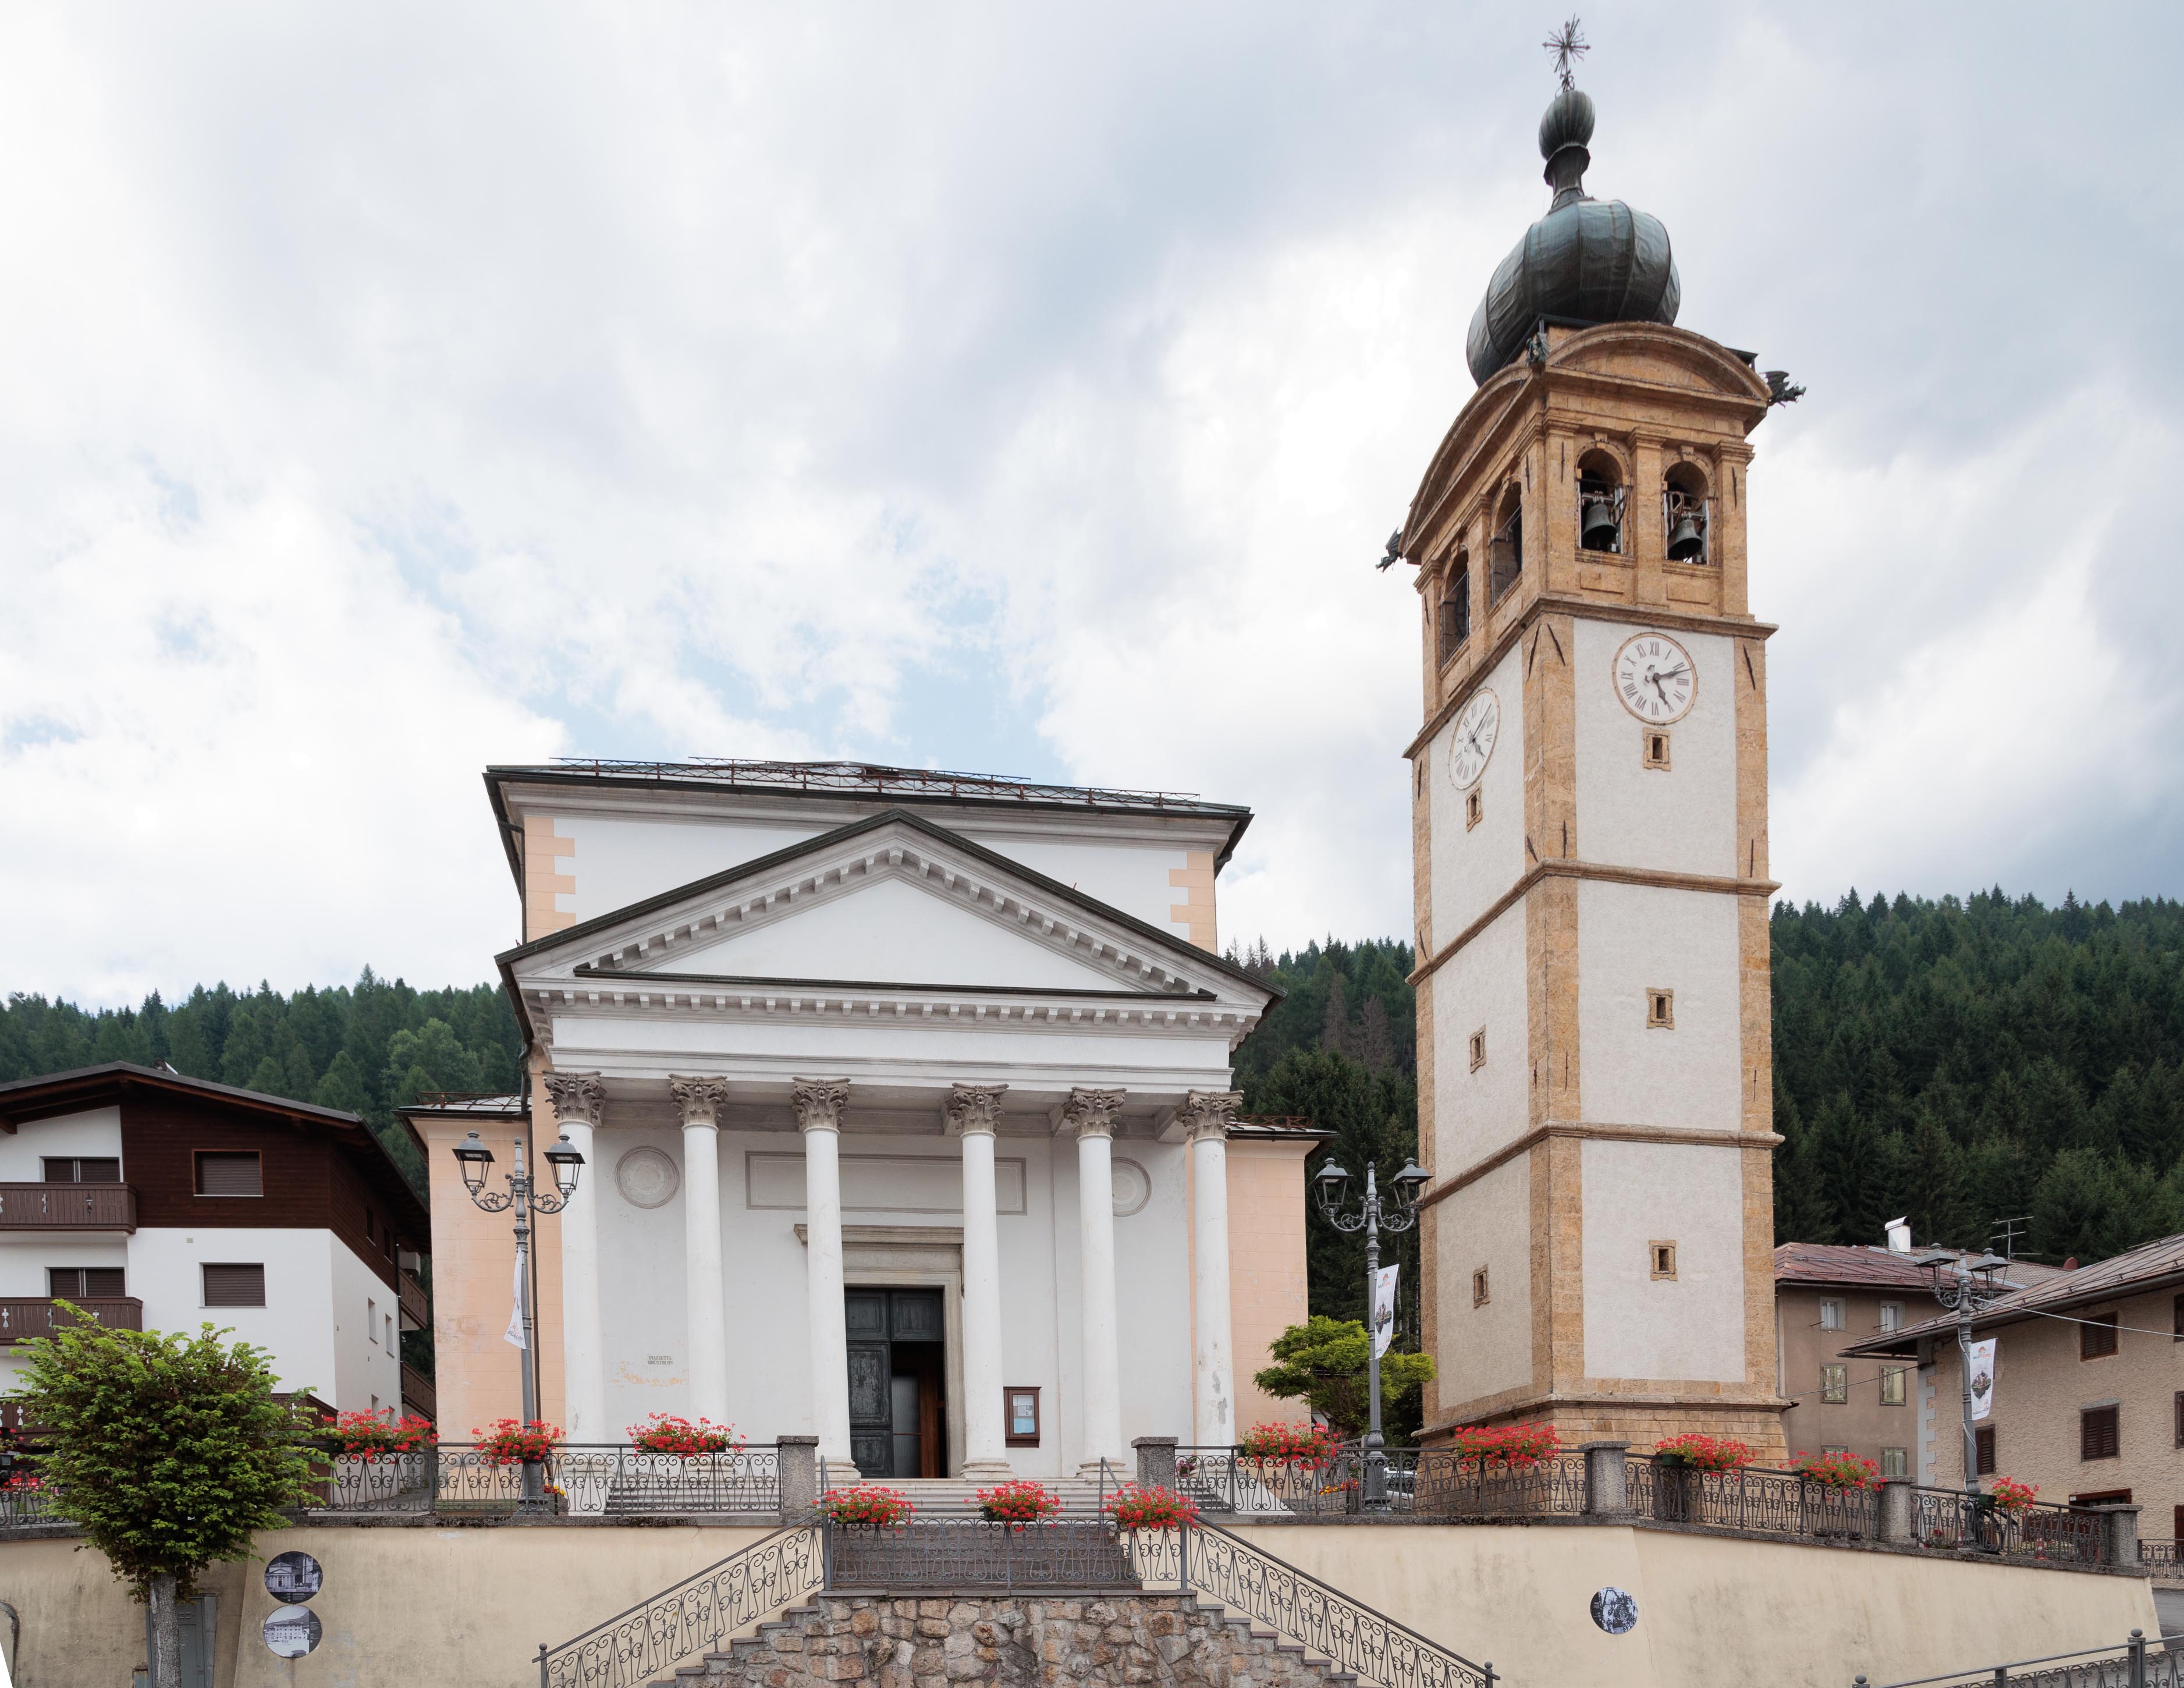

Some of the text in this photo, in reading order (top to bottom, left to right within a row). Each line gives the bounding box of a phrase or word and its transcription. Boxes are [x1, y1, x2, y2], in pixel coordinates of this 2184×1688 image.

[1635, 643, 1646, 659] XI
[1650, 641, 1659, 656] XII
[1624, 655, 1637, 666] X
[1621, 671, 1633, 680] IX
[1676, 678, 1689, 686] III
[1652, 701, 1659, 716] VI
